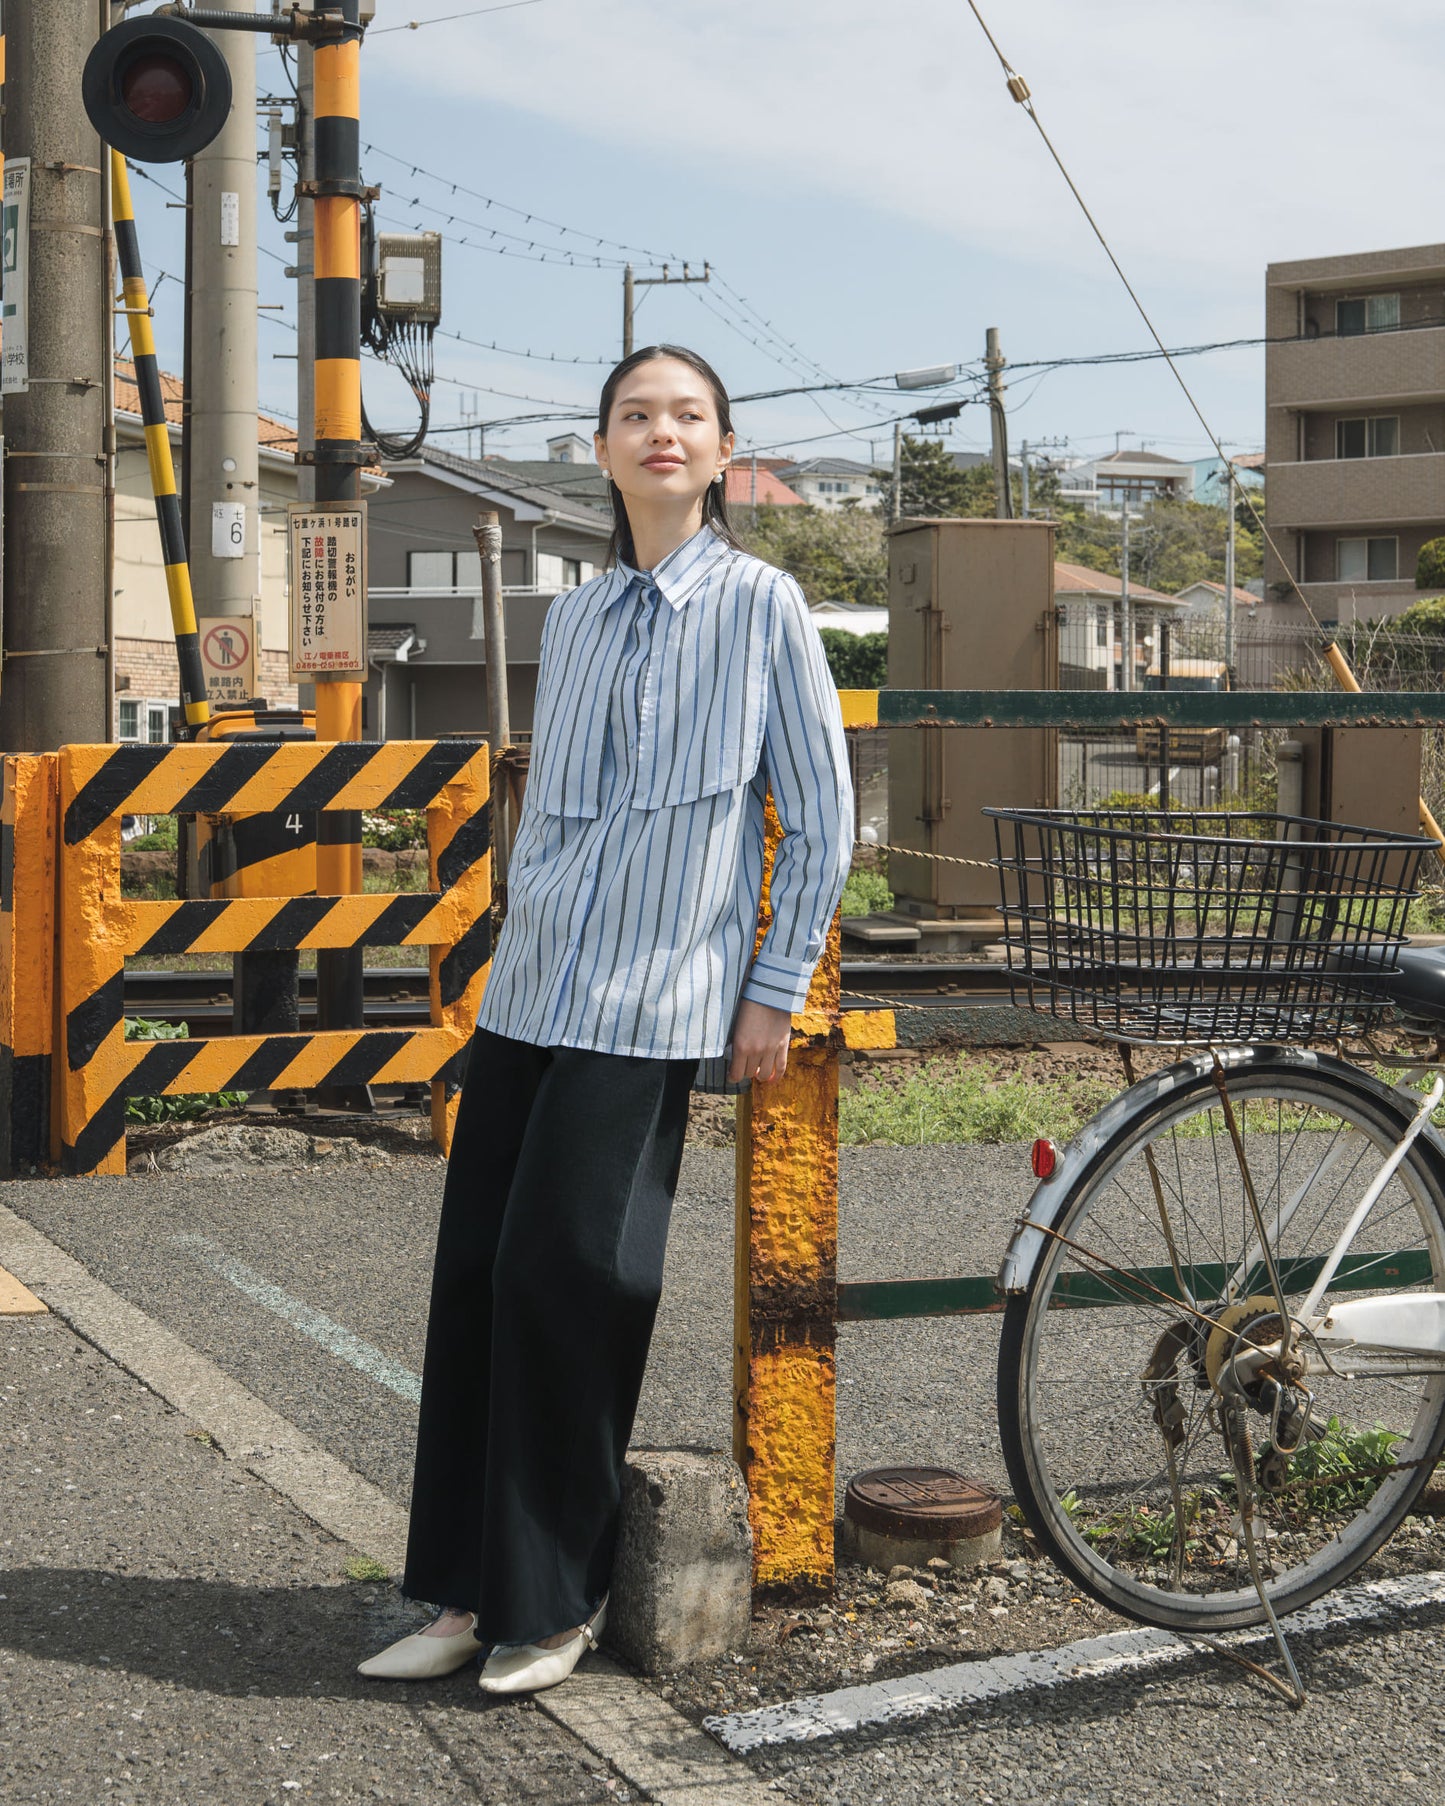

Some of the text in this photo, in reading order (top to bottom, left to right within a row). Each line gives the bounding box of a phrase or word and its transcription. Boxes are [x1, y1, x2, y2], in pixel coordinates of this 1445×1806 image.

[231, 521, 242, 544] 6
[327, 536, 337, 601] 踏切警報機の
[345, 552, 356, 597] おねがい
[301, 537, 312, 647] 下記にお知らせ下さい
[314, 536, 325, 636] 故障にお気付の方は
[207, 689, 249, 700] 立入禁止
[209, 676, 243, 687] 線路内
[285, 813, 303, 834] 4
